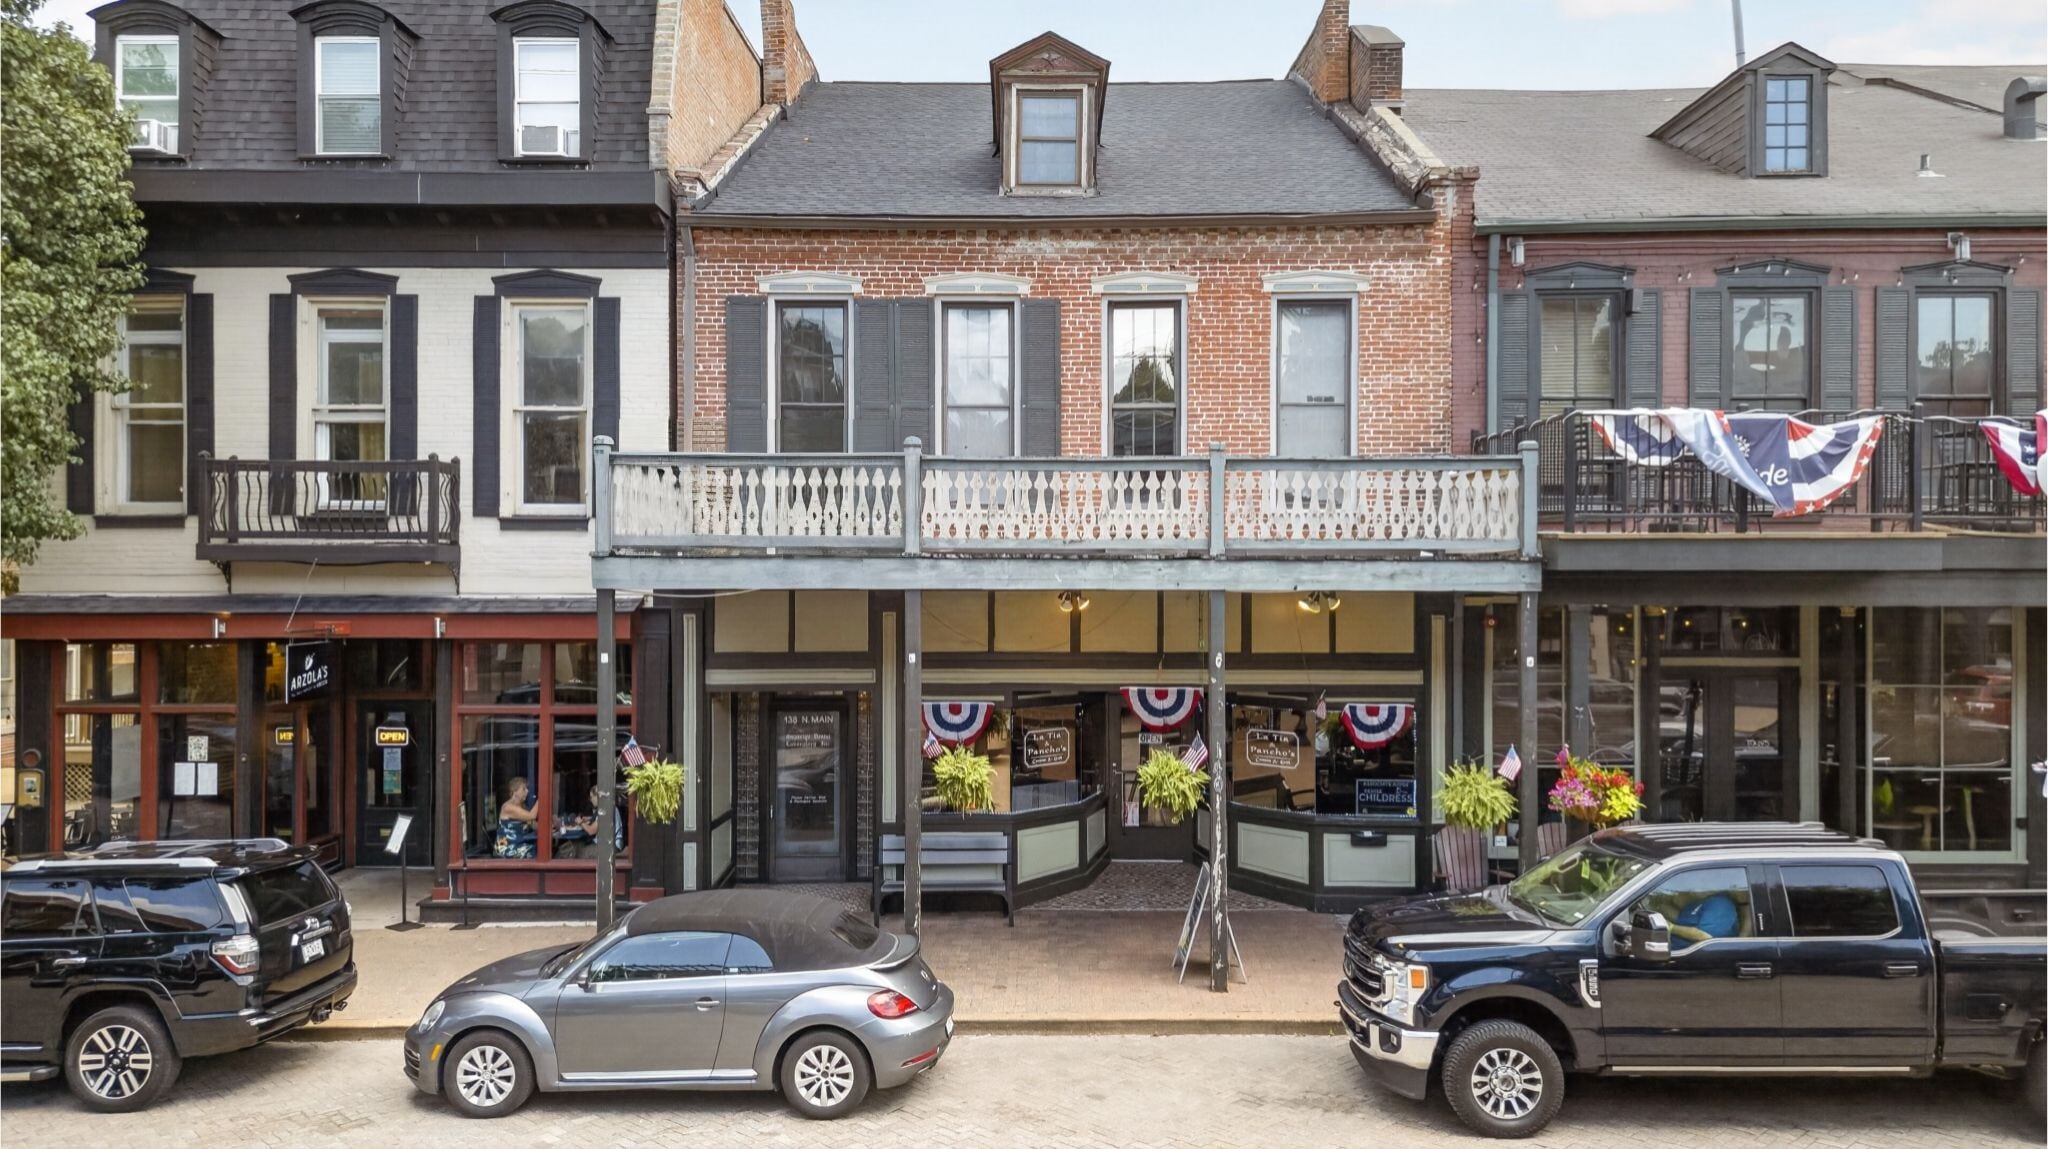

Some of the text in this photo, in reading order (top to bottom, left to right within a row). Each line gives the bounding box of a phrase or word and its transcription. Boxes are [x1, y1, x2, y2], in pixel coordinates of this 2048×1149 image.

[290, 665, 328, 692] ARZOLA'S
[811, 715, 834, 724] MAIN
[379, 732, 406, 741] OPEN
[1358, 792, 1413, 803] CHILDRESS
